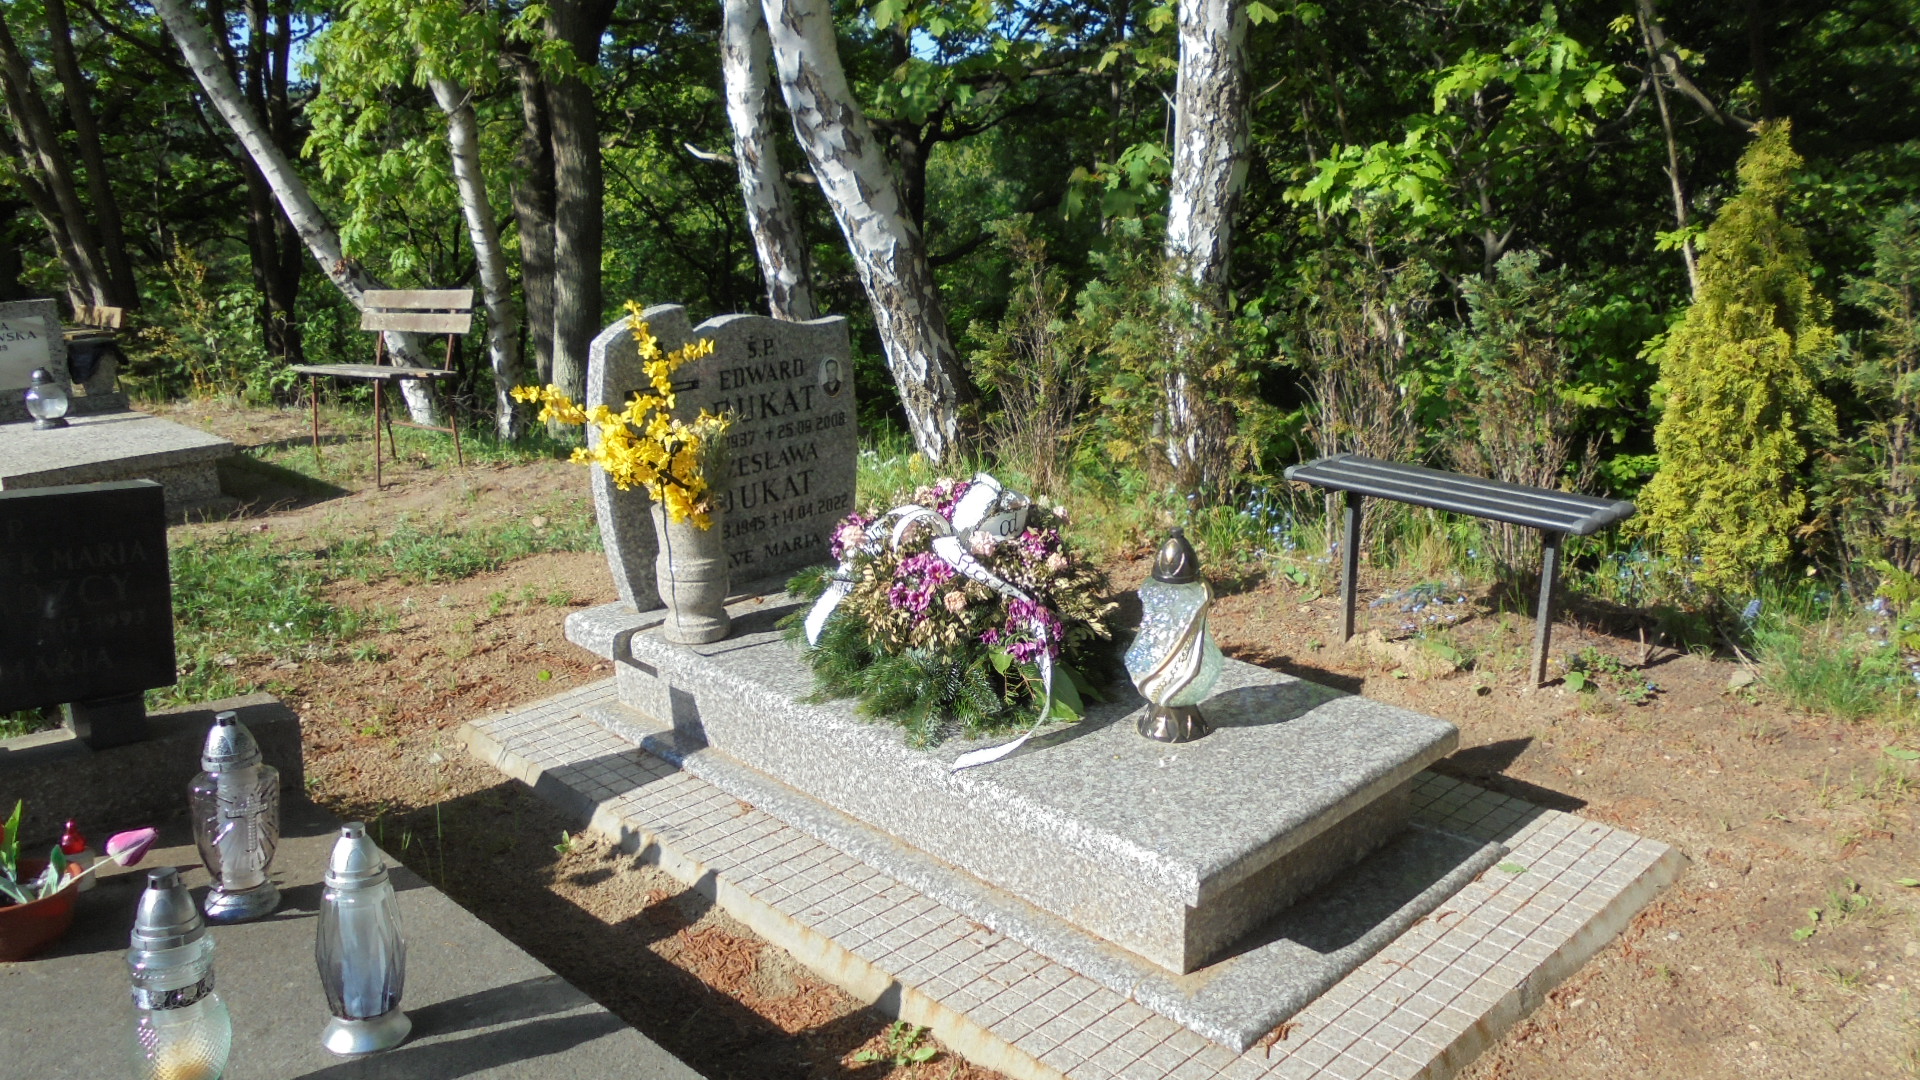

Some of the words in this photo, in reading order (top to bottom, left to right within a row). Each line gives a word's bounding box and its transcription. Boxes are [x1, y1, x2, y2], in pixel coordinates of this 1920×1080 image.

[719, 358, 804, 391] EDWARD
[51, 531, 149, 572] MARIA
[764, 532, 822, 558] MARIA
